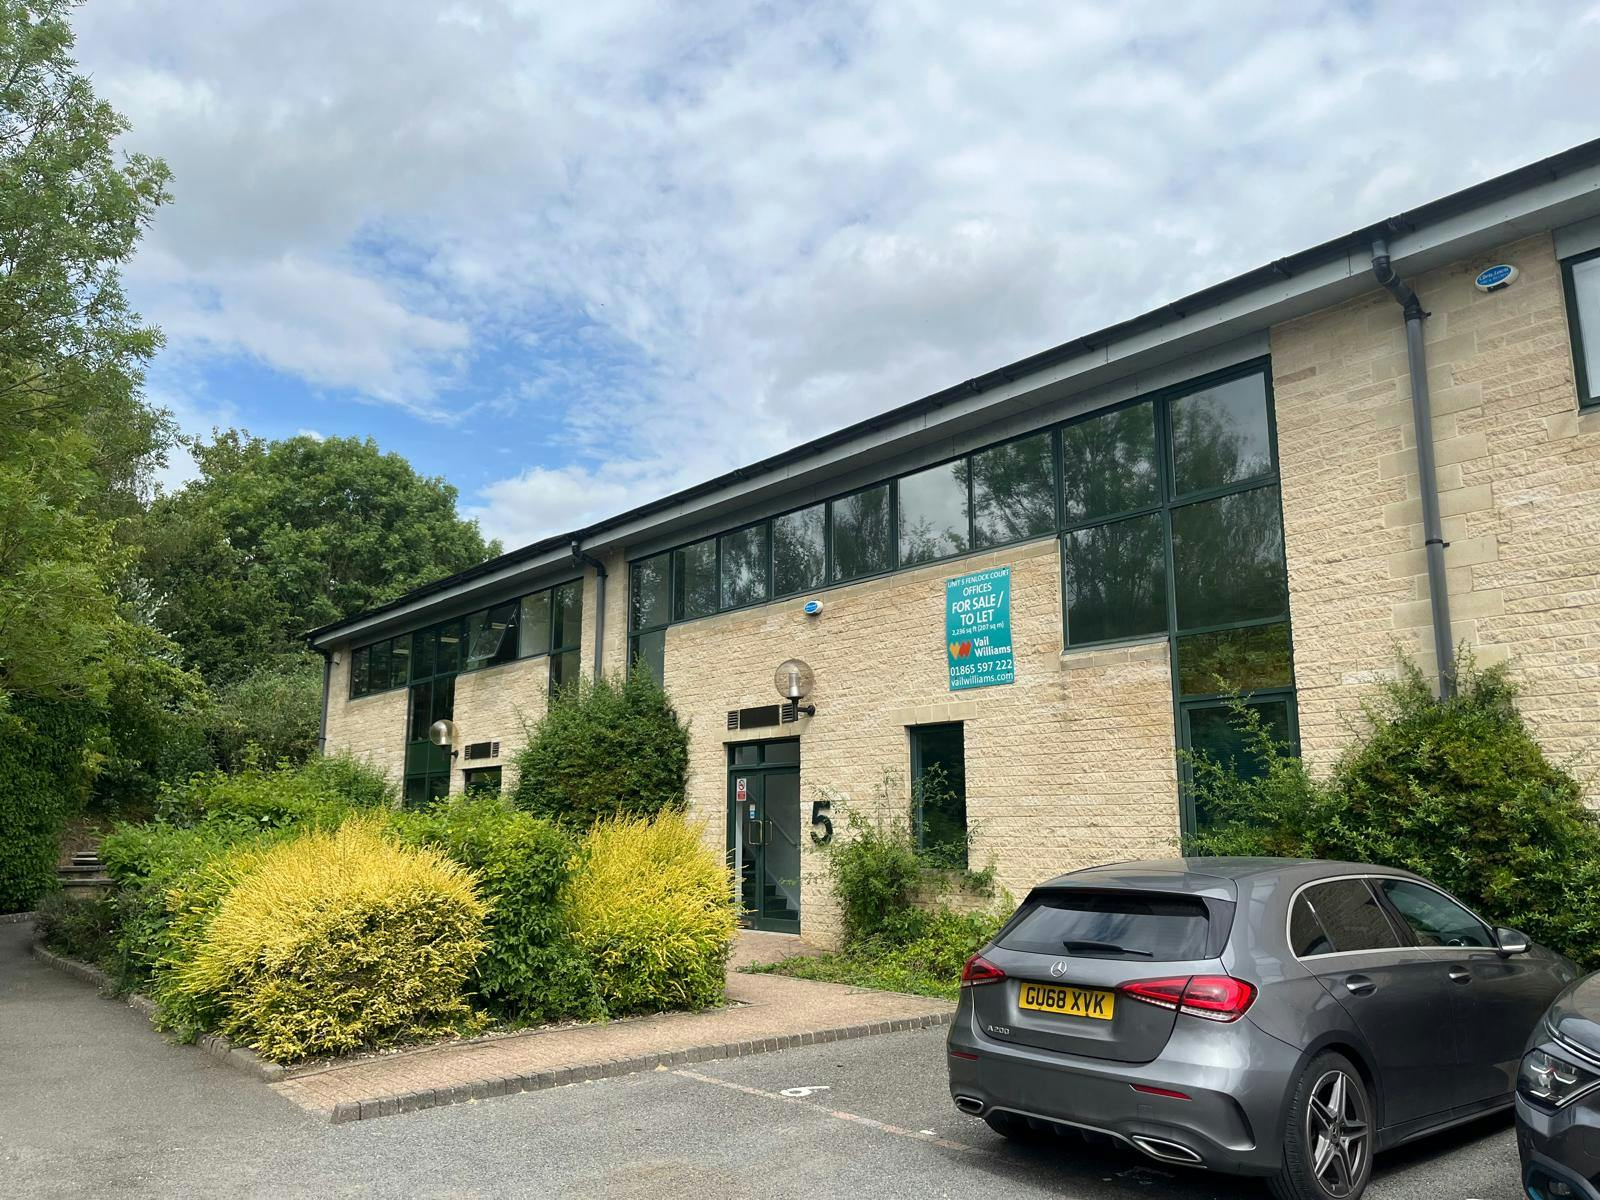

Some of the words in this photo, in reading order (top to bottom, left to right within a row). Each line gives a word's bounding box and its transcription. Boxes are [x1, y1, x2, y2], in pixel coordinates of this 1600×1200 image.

[948, 579, 960, 588] UNIT
[966, 574, 989, 585] FENLOCK
[989, 569, 1009, 579] COURT
[963, 582, 992, 596] OFFICES
[952, 600, 971, 614] FOR
[972, 594, 996, 610] SALE
[960, 613, 974, 626] TO
[976, 609, 994, 623] LET
[974, 636, 989, 647] Vail
[974, 645, 1011, 658] Williams
[950, 664, 975, 677] 01865
[977, 661, 993, 673] 597
[996, 659, 1012, 671] 222
[951, 672, 1013, 687] vailwilliams.com
[810, 800, 833, 846] 5
[1026, 986, 1067, 1009] GU68
[1071, 991, 1106, 1014] XVK
